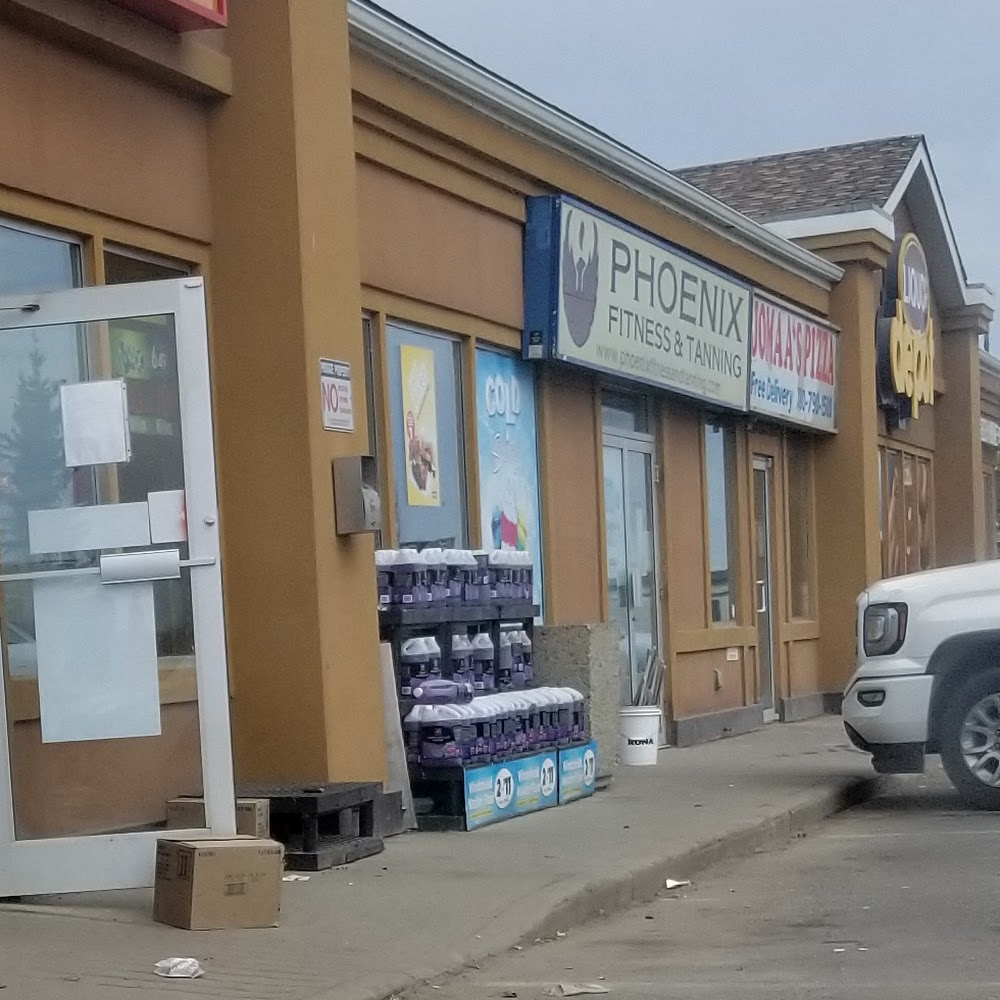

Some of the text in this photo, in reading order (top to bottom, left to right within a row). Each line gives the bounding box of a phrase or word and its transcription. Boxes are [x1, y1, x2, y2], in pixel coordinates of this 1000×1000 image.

[610, 238, 743, 343] PHOENIX
[608, 305, 742, 379] FITNESS & TANNING
[802, 322, 834, 386] PIZZA
[321, 382, 339, 413] NO
